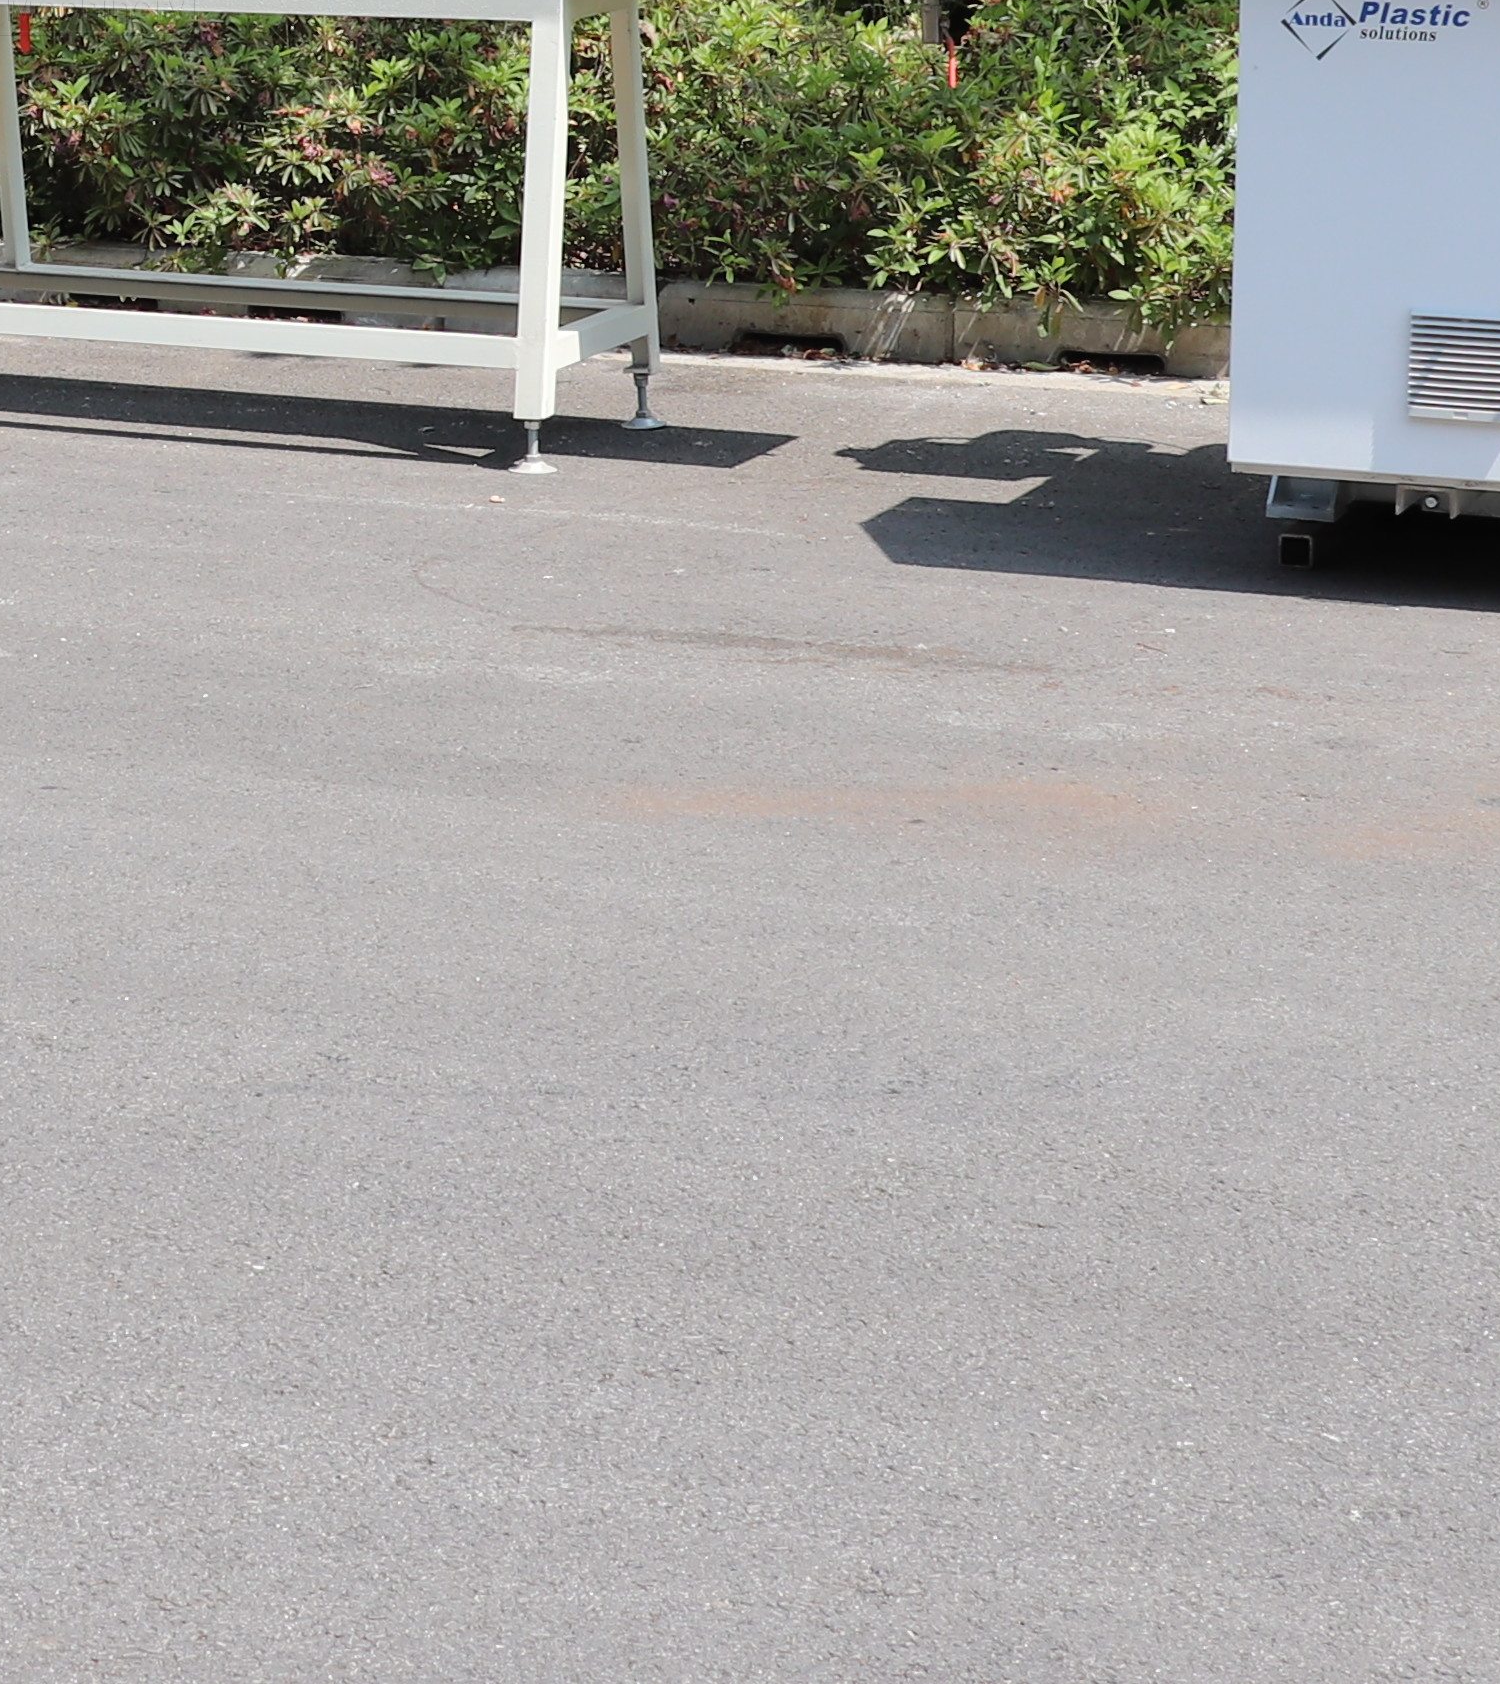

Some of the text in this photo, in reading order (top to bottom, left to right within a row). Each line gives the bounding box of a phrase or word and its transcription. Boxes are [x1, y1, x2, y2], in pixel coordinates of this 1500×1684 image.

[1289, 11, 1346, 28] Anda
[1359, 1, 1471, 27] Plastic
[1359, 26, 1437, 42] solutions
